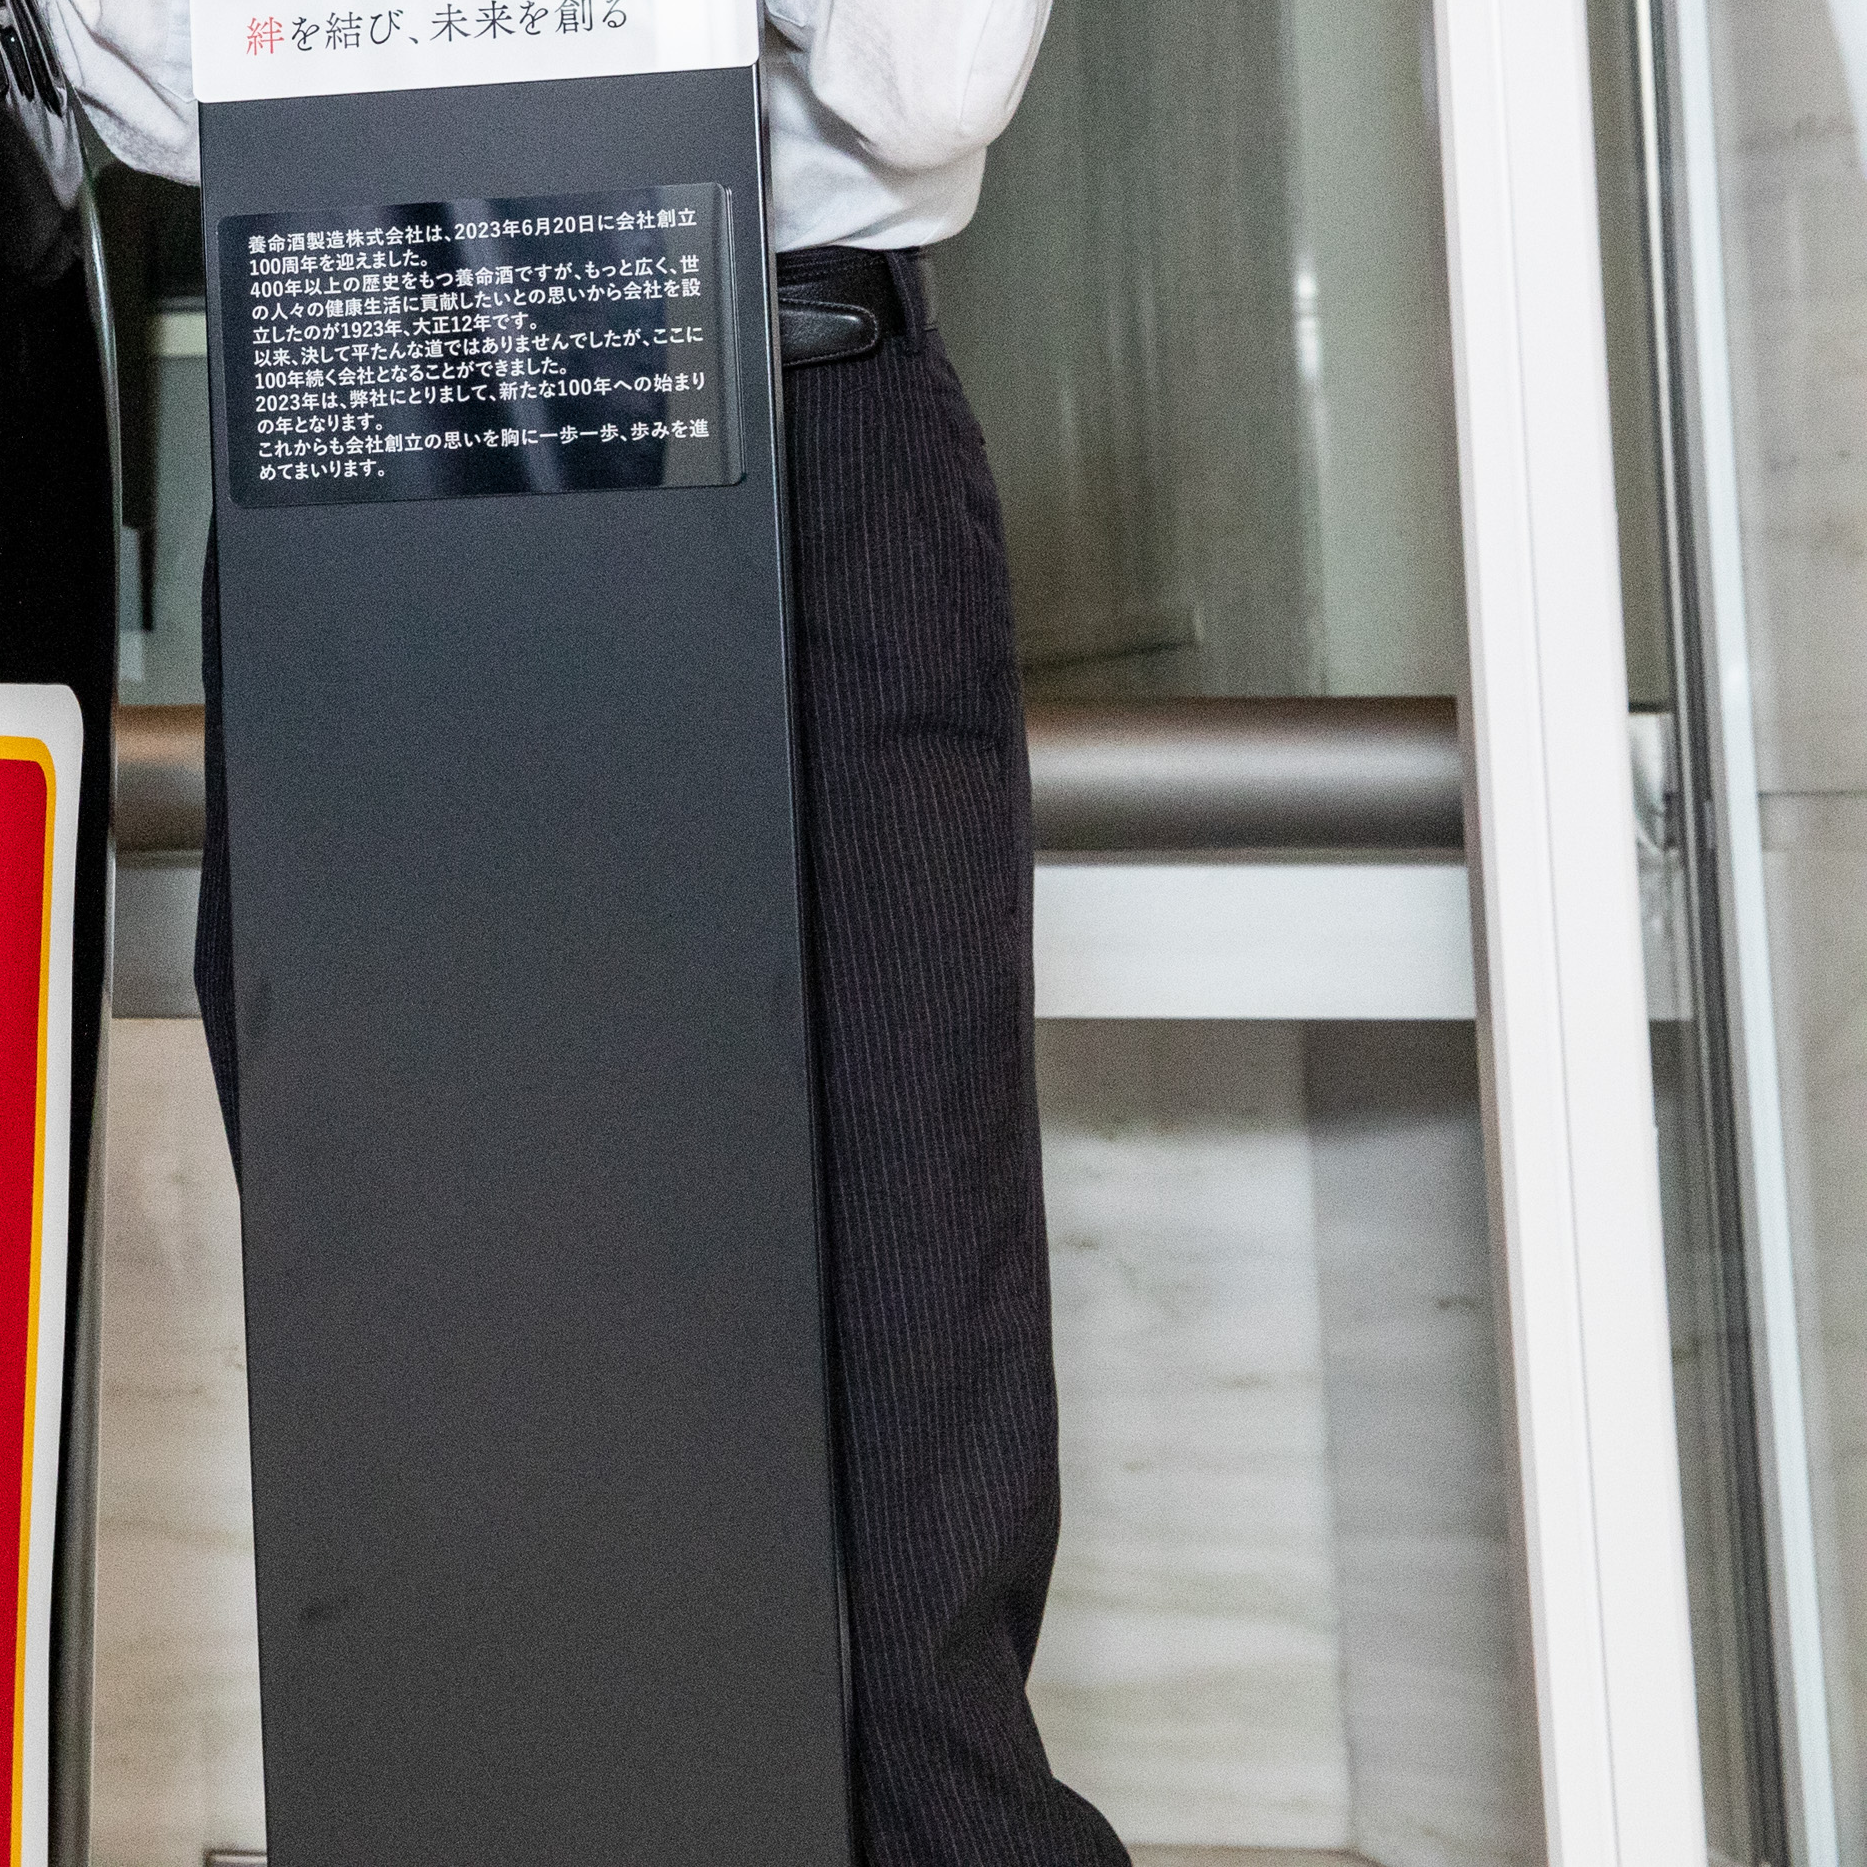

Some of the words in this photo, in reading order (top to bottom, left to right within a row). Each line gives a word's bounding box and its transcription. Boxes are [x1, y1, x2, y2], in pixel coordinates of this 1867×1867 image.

[248, 207, 697, 255] 養命酒製造株式会社は、2023年6月20日に会社創立
[250, 248, 429, 276] 100周年を迎えました。
[250, 254, 700, 299] 400年以上の歴史をもつ養命酒ですが、もっと広く、世
[251, 277, 701, 321] の人々の健康生活に貢献したいとの思いから会社を設
[253, 311, 537, 345] 立したのが1923年、大正12年です。
[254, 325, 704, 367] 以来、決して平たんな道ではありませんでしたが、ここに
[254, 356, 567, 390] 100年続く会社となることができました。
[255, 372, 705, 412] 2023年は、弊社にとりまして、新たな100年への始まり
[257, 412, 383, 435] の年となります。
[258, 419, 709, 459] これからも会社創立の思いを胸に一歩一歩、歩みを進
[259, 458, 385, 481] めてまいります。
